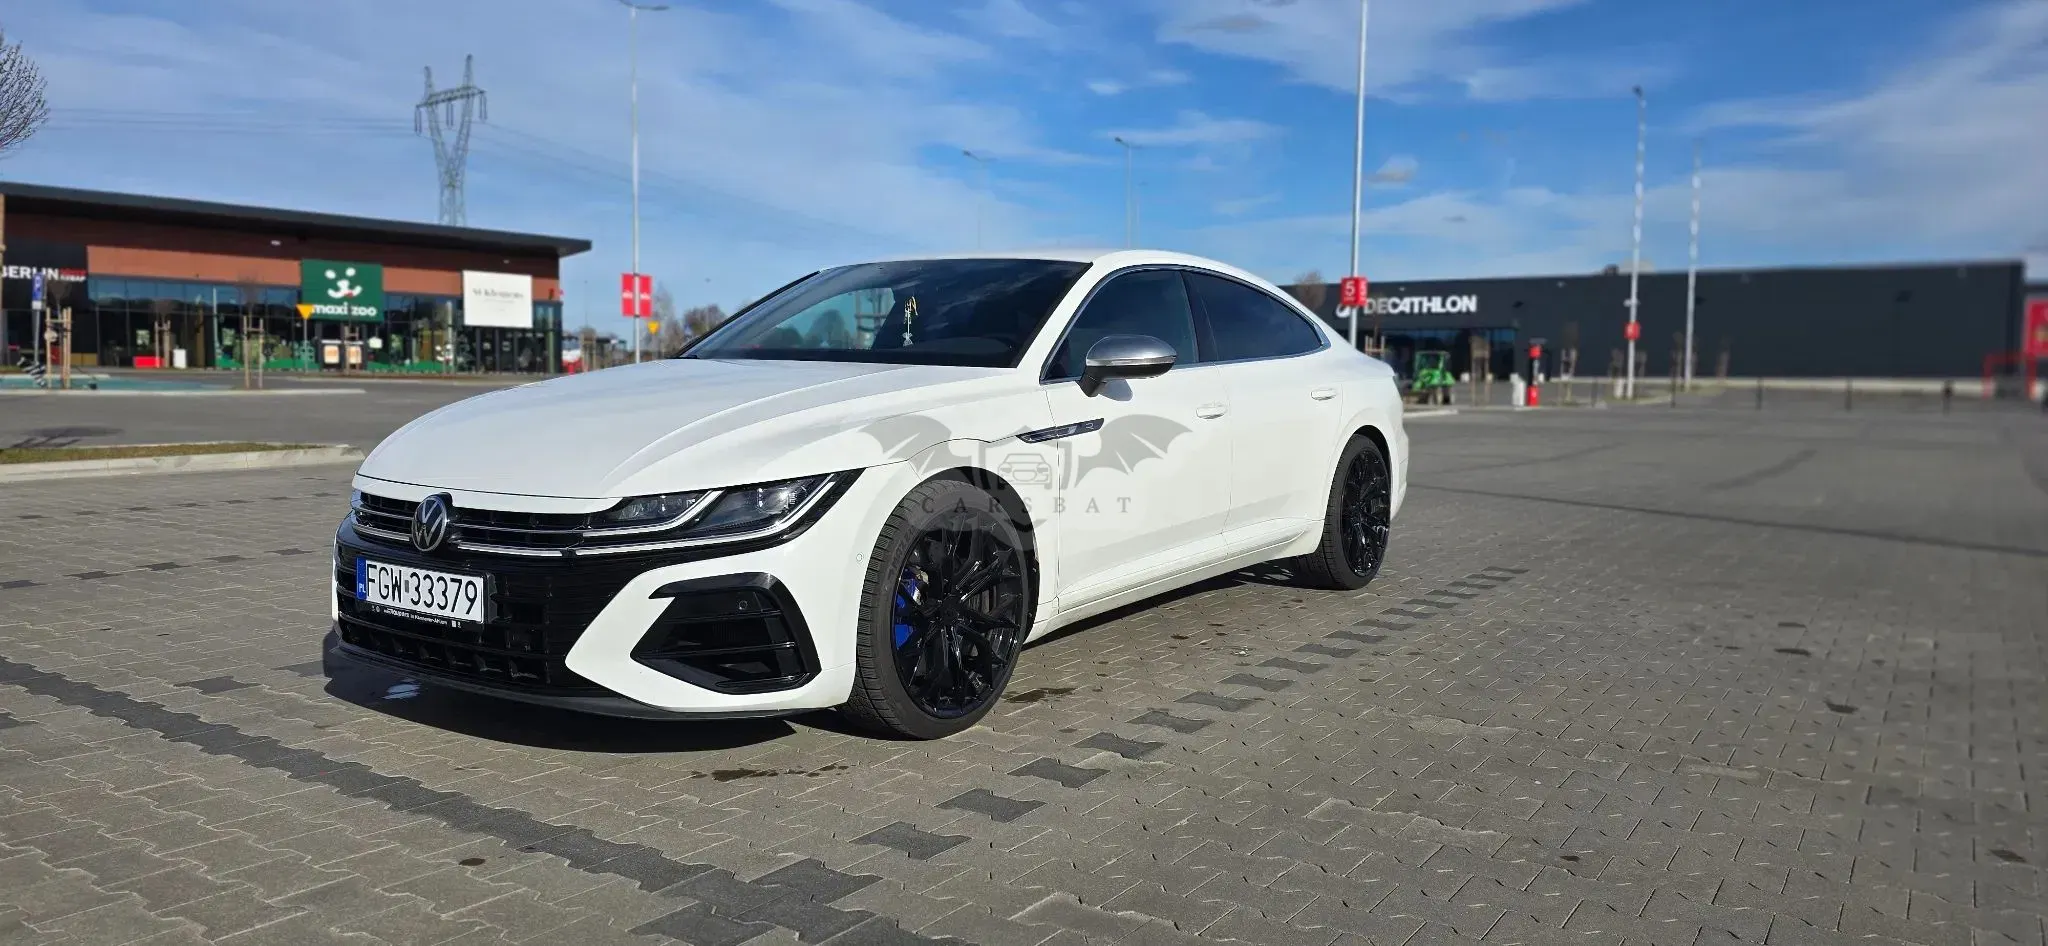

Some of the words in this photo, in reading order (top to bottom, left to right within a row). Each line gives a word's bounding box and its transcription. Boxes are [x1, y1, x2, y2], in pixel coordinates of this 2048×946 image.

[1344, 281, 1355, 296] 5
[313, 301, 348, 316] maxi
[350, 305, 377, 317] zoo
[1364, 295, 1477, 315] DECATHLON
[359, 583, 366, 593] PL
[366, 564, 402, 603] FGW
[410, 572, 477, 615] 33379
